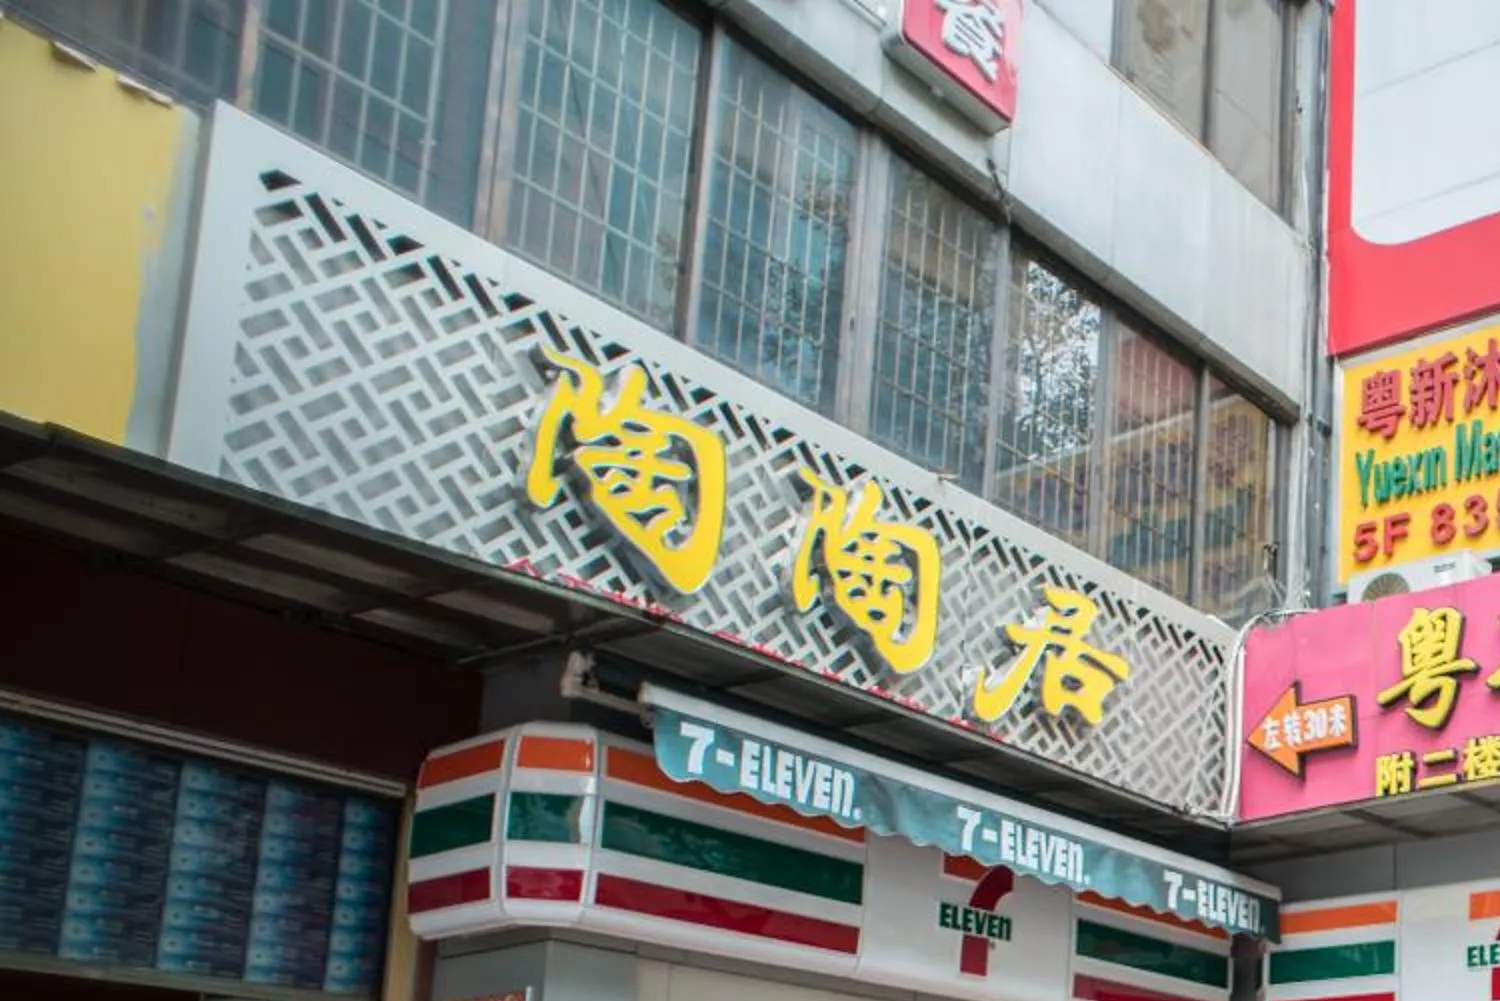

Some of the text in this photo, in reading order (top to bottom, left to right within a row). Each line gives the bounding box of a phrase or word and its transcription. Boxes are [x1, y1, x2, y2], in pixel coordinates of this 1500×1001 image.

[1356, 448, 1447, 508] Yuexin
[527, 346, 1129, 724] 陶陶居
[1354, 511, 1411, 562] 5F
